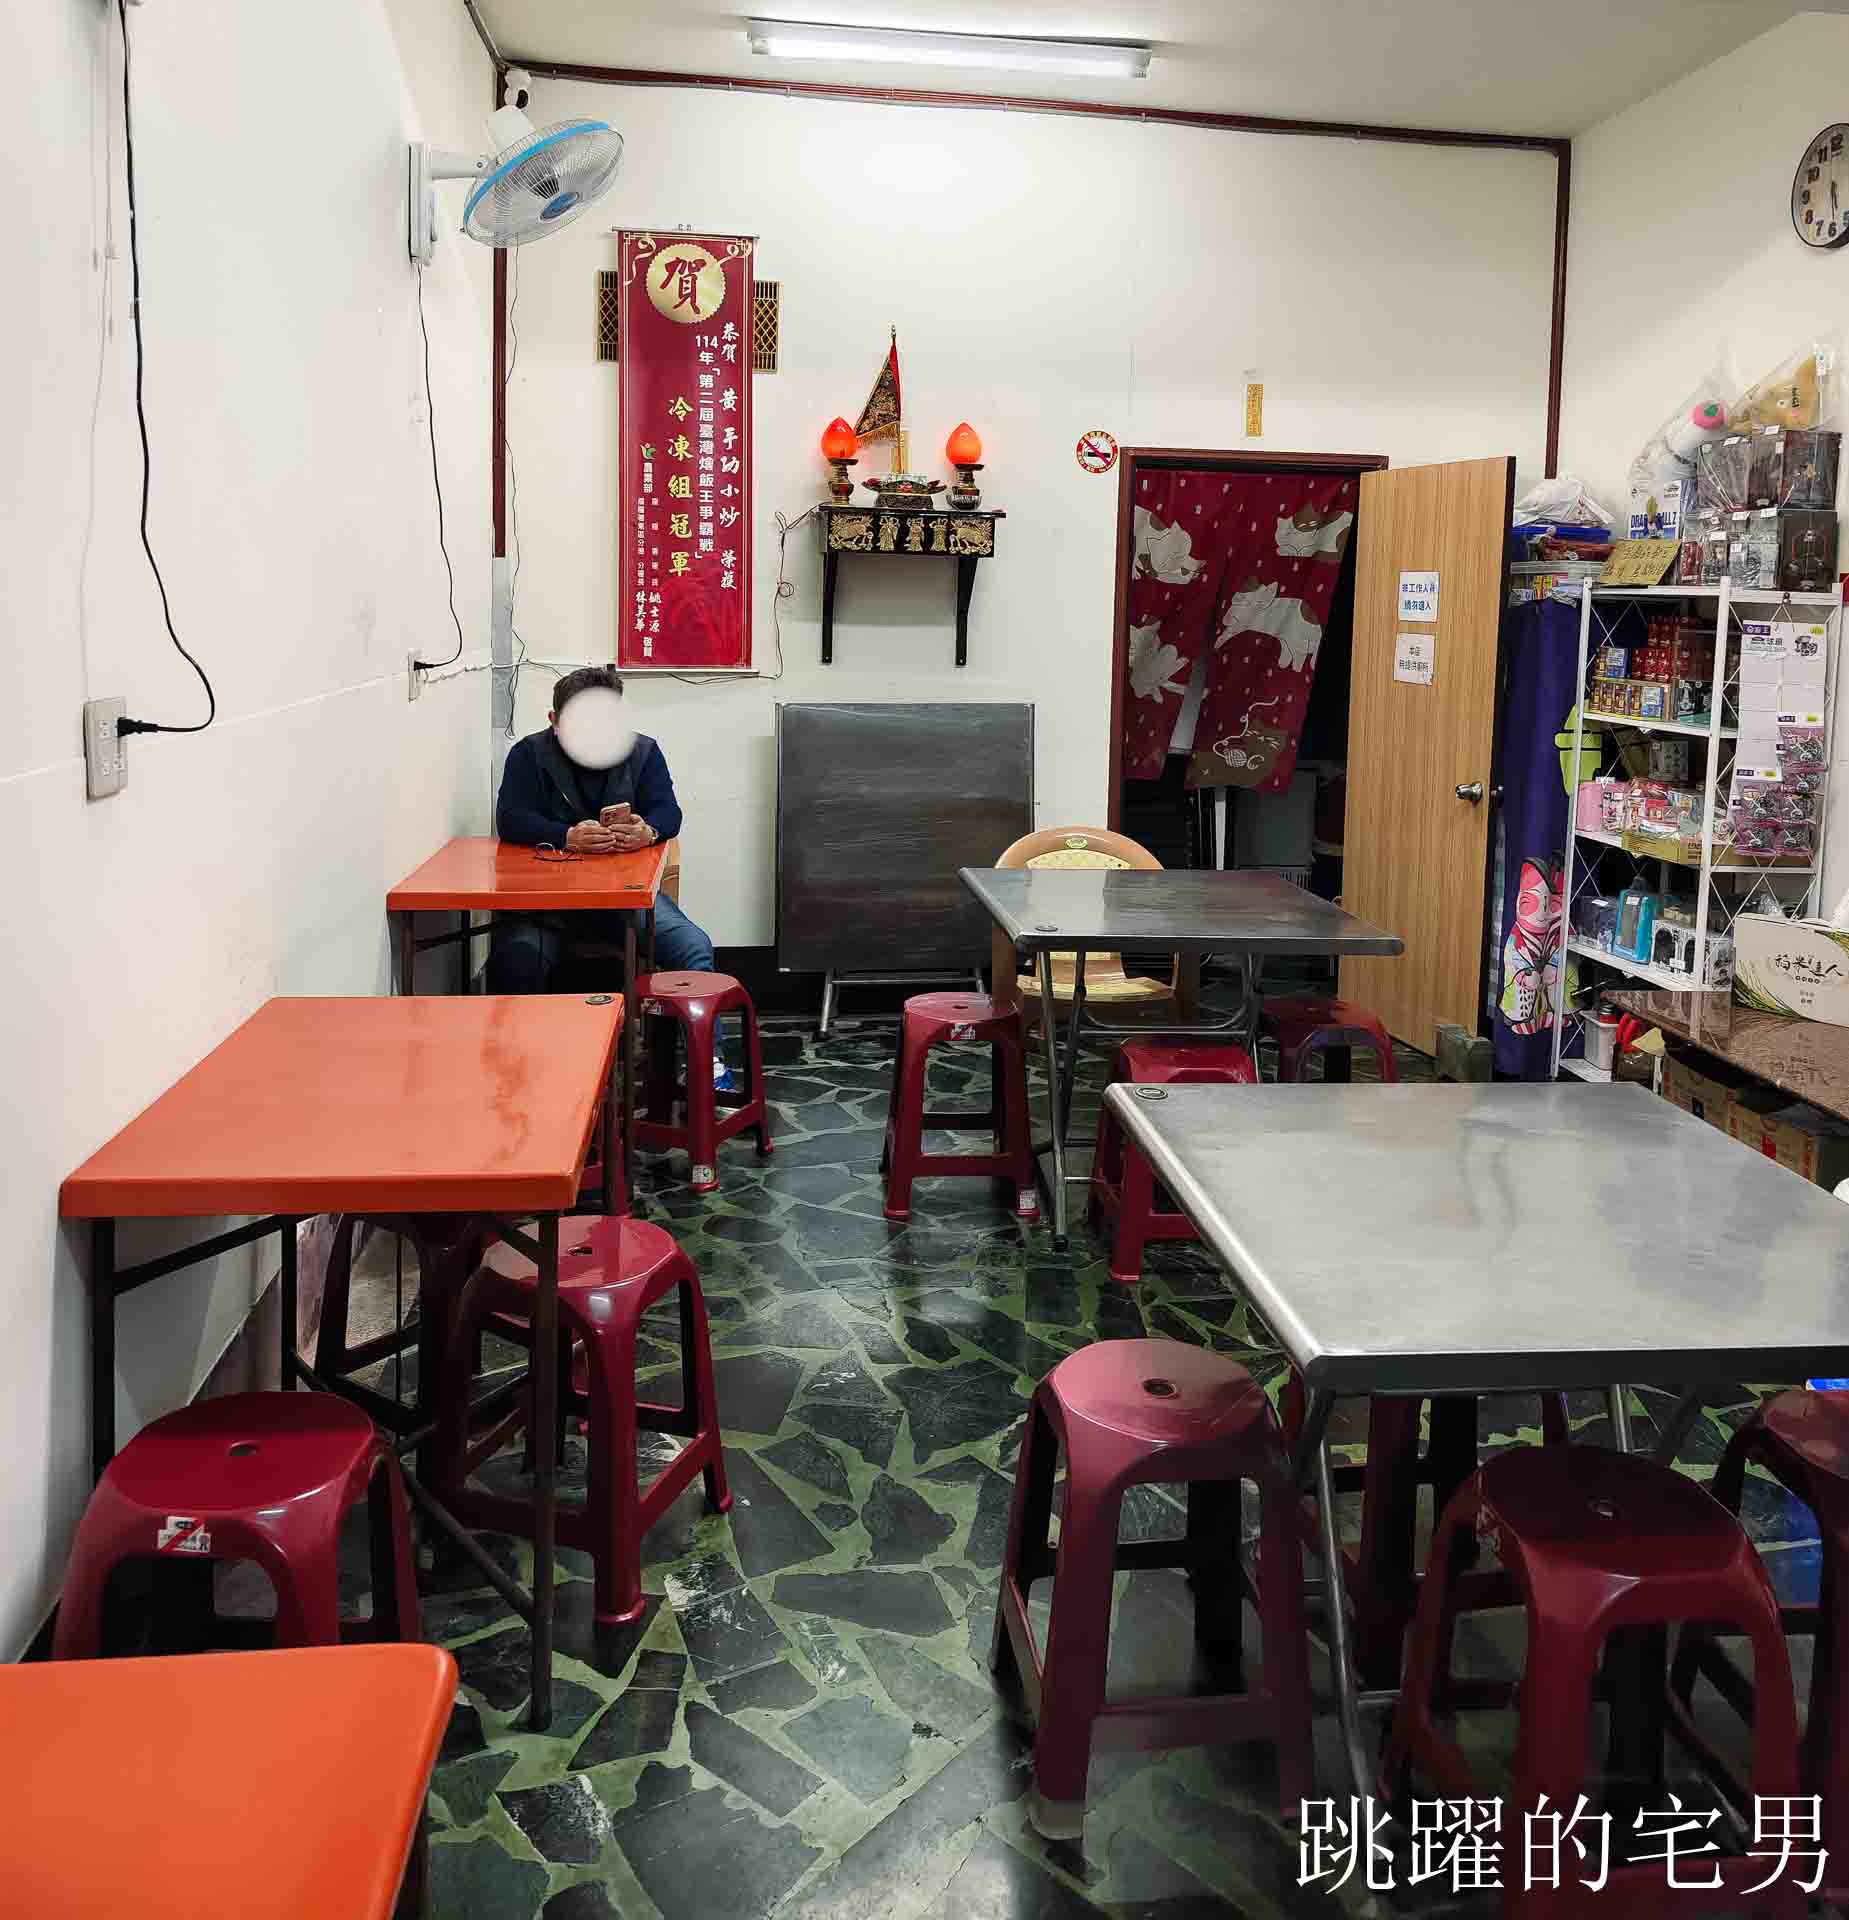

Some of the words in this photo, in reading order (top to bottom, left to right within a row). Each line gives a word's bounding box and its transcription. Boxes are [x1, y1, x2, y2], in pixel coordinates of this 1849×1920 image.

[1807, 166, 1820, 184] 10
[1801, 190, 1810, 205] 9
[1805, 209, 1814, 225] 8
[1815, 219, 1824, 237] 7
[1828, 222, 1837, 238] 6
[659, 256, 707, 314] 賀
[721, 321, 740, 363] 恭賀
[667, 396, 694, 576] 冷凍組冠軍
[720, 549, 738, 590] 榮獲
